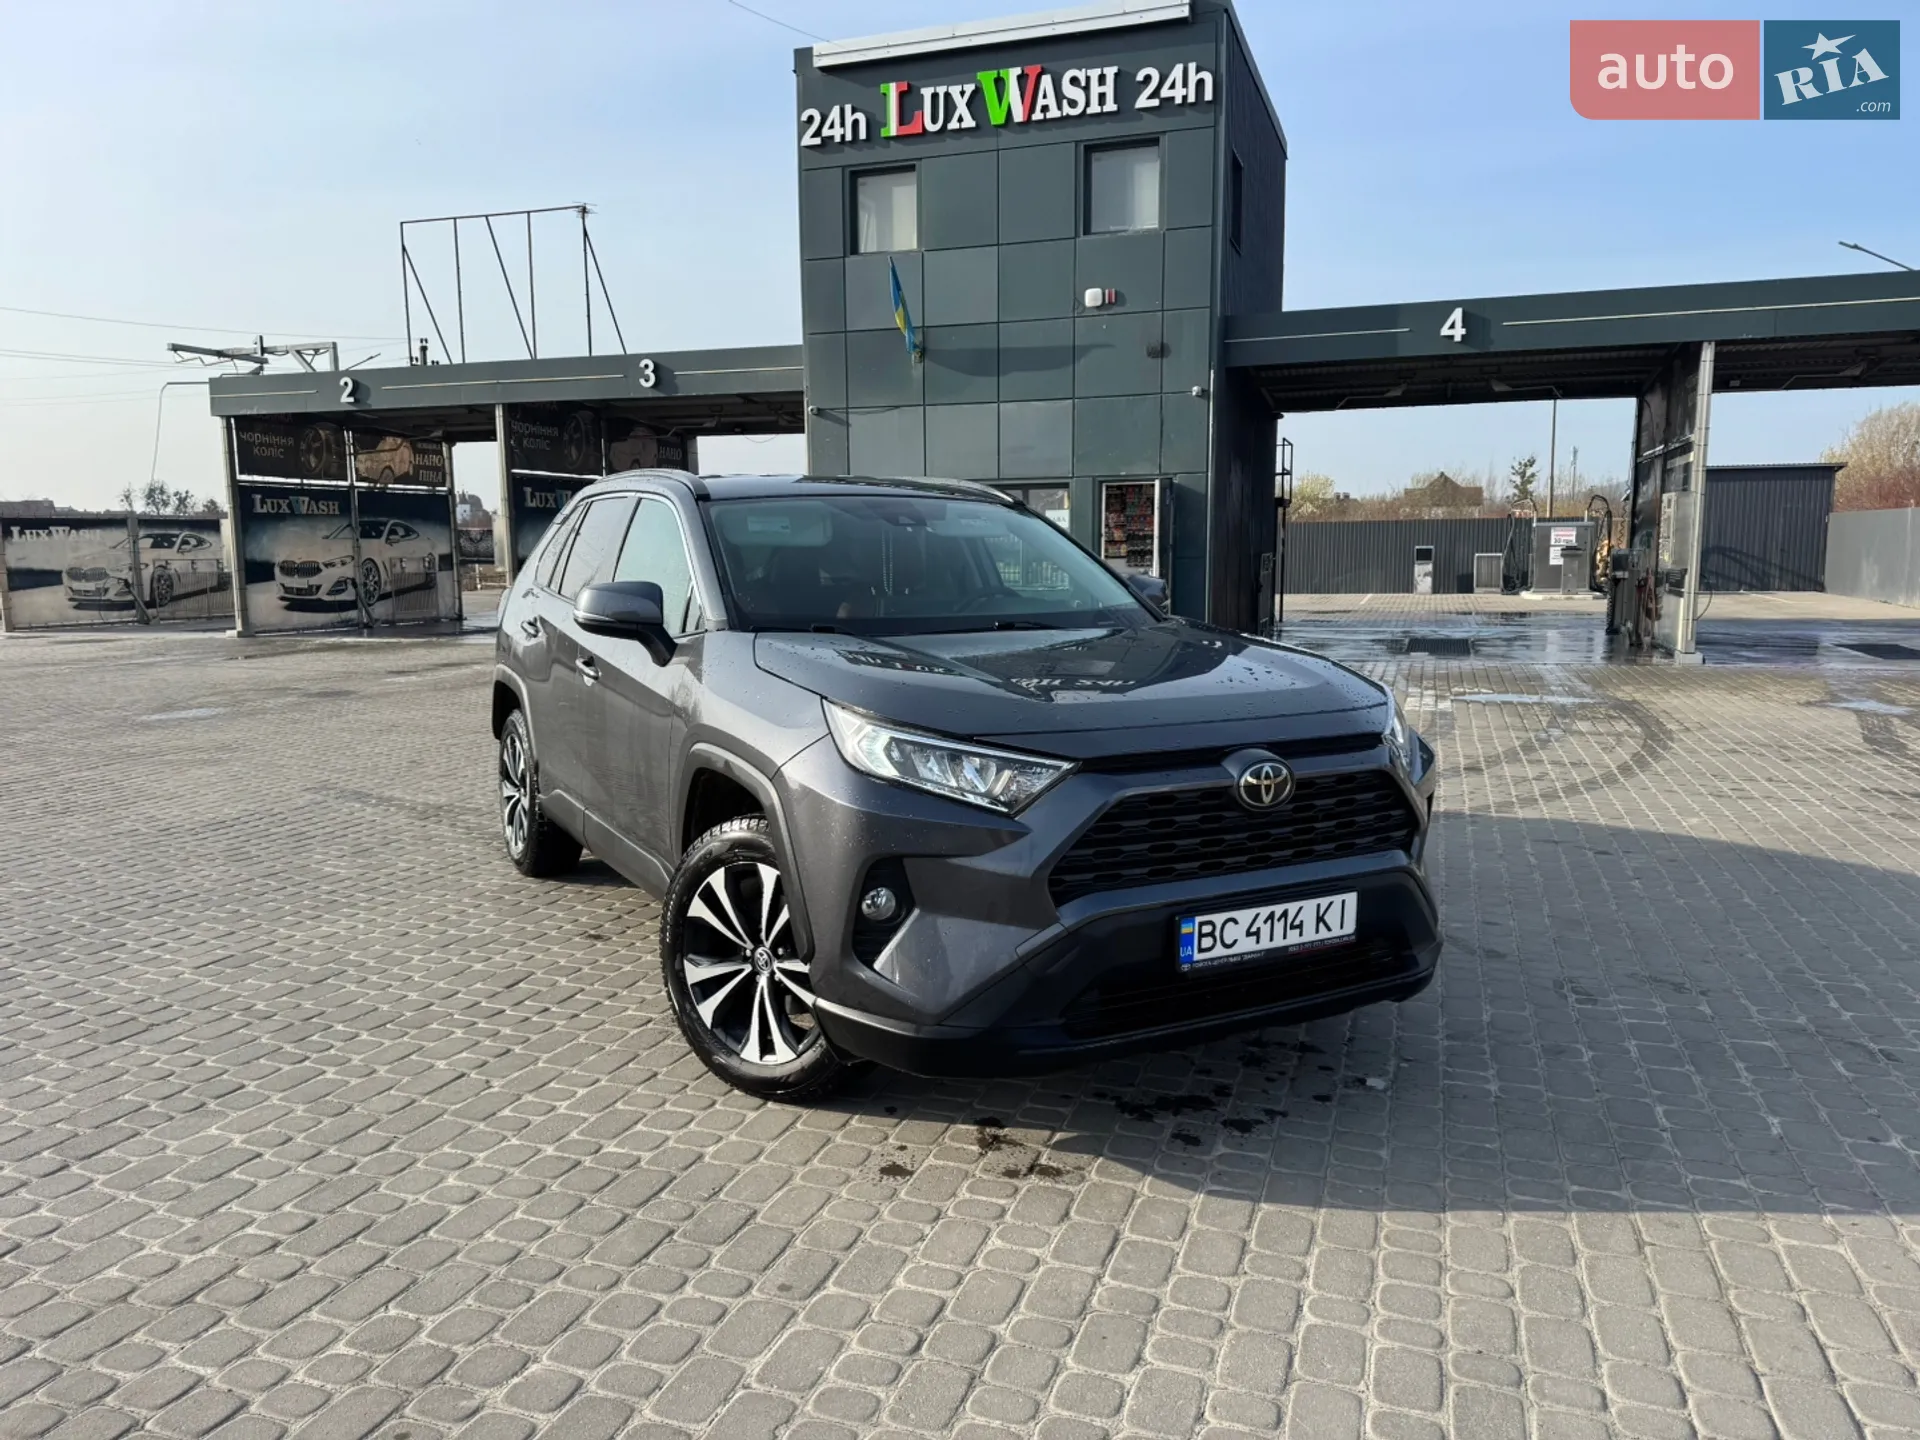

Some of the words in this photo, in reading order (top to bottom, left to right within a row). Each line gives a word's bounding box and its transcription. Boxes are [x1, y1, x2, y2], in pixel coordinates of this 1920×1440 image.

[800, 103, 868, 148] 24h
[1134, 61, 1214, 110] 24h
[1439, 306, 1467, 343] 4
[638, 358, 656, 389] 3
[339, 376, 356, 404] 2
[252, 445, 285, 459] коліс
[415, 453, 444, 467] НАНО
[1197, 917, 1240, 954] BC
[1245, 905, 1304, 945] 4114
[1315, 899, 1347, 935] KI
[1180, 944, 1193, 958] UA
